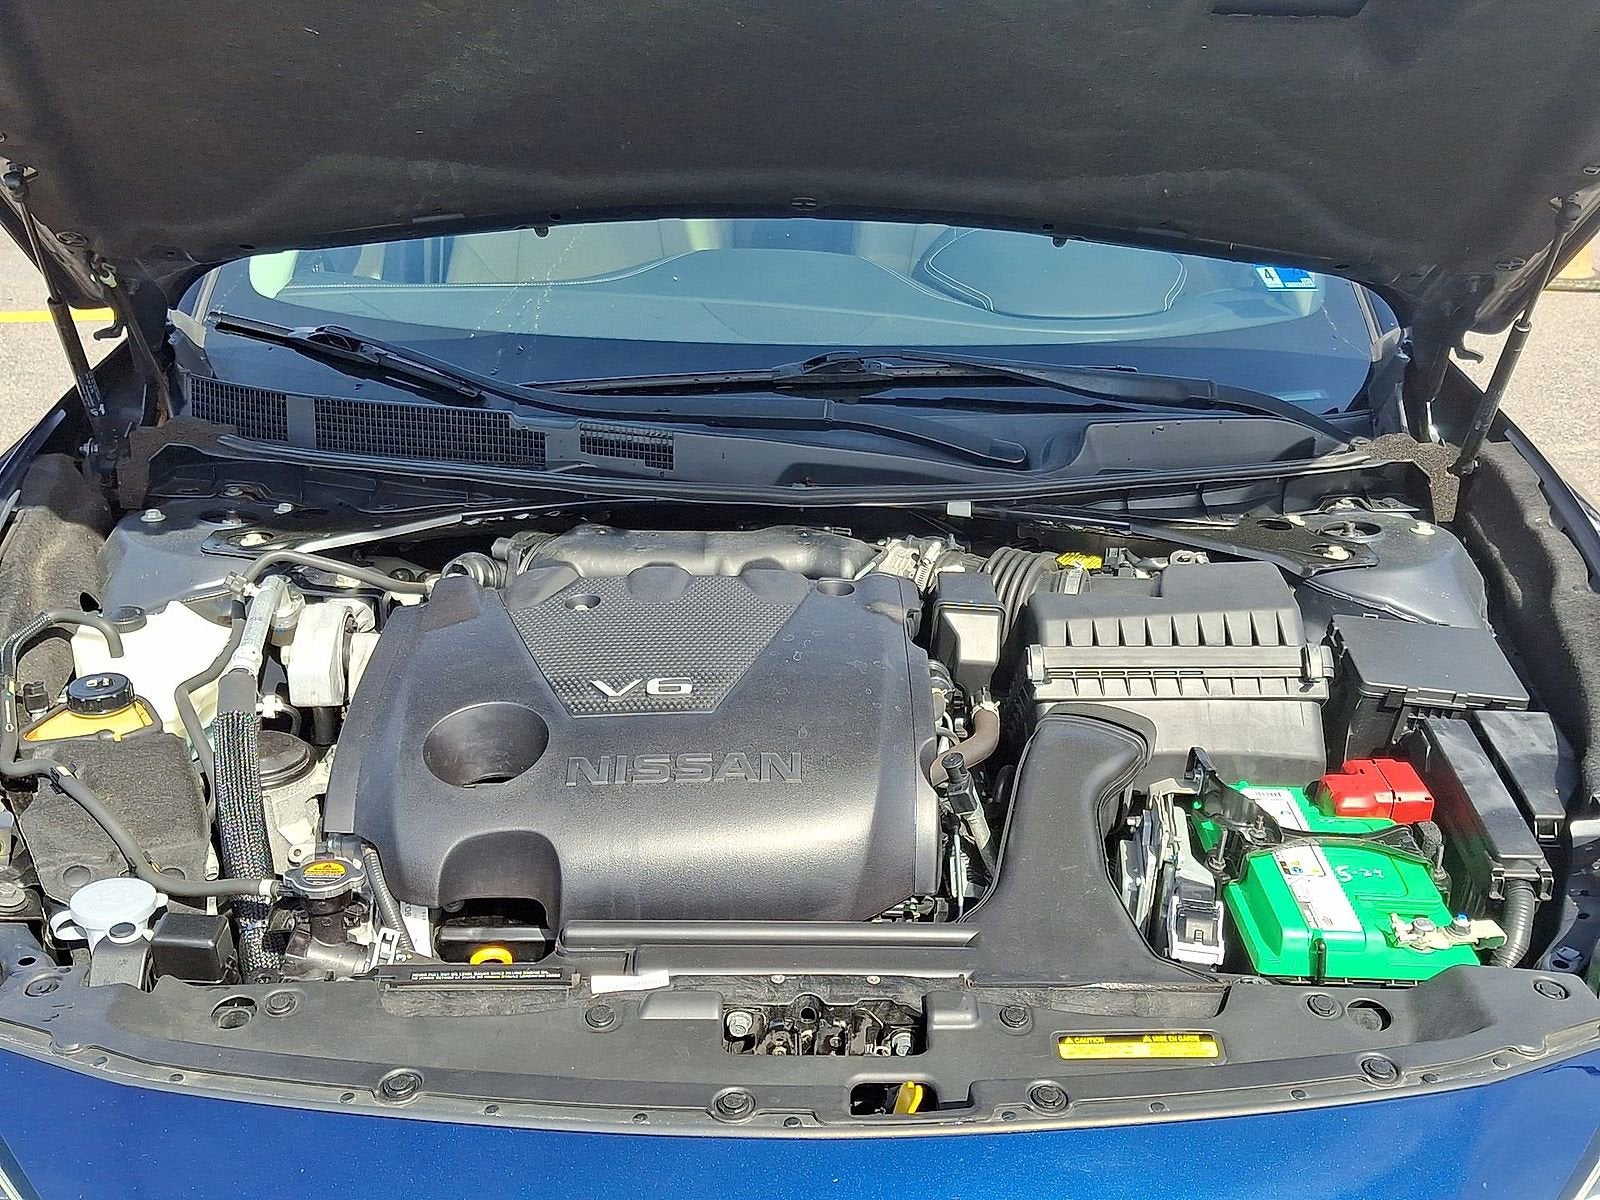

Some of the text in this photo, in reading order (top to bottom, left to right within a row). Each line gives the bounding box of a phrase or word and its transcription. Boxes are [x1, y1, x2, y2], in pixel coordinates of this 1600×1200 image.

[1264, 268, 1275, 281] 4
[590, 677, 693, 698] V6
[566, 752, 802, 787] NISSAN
